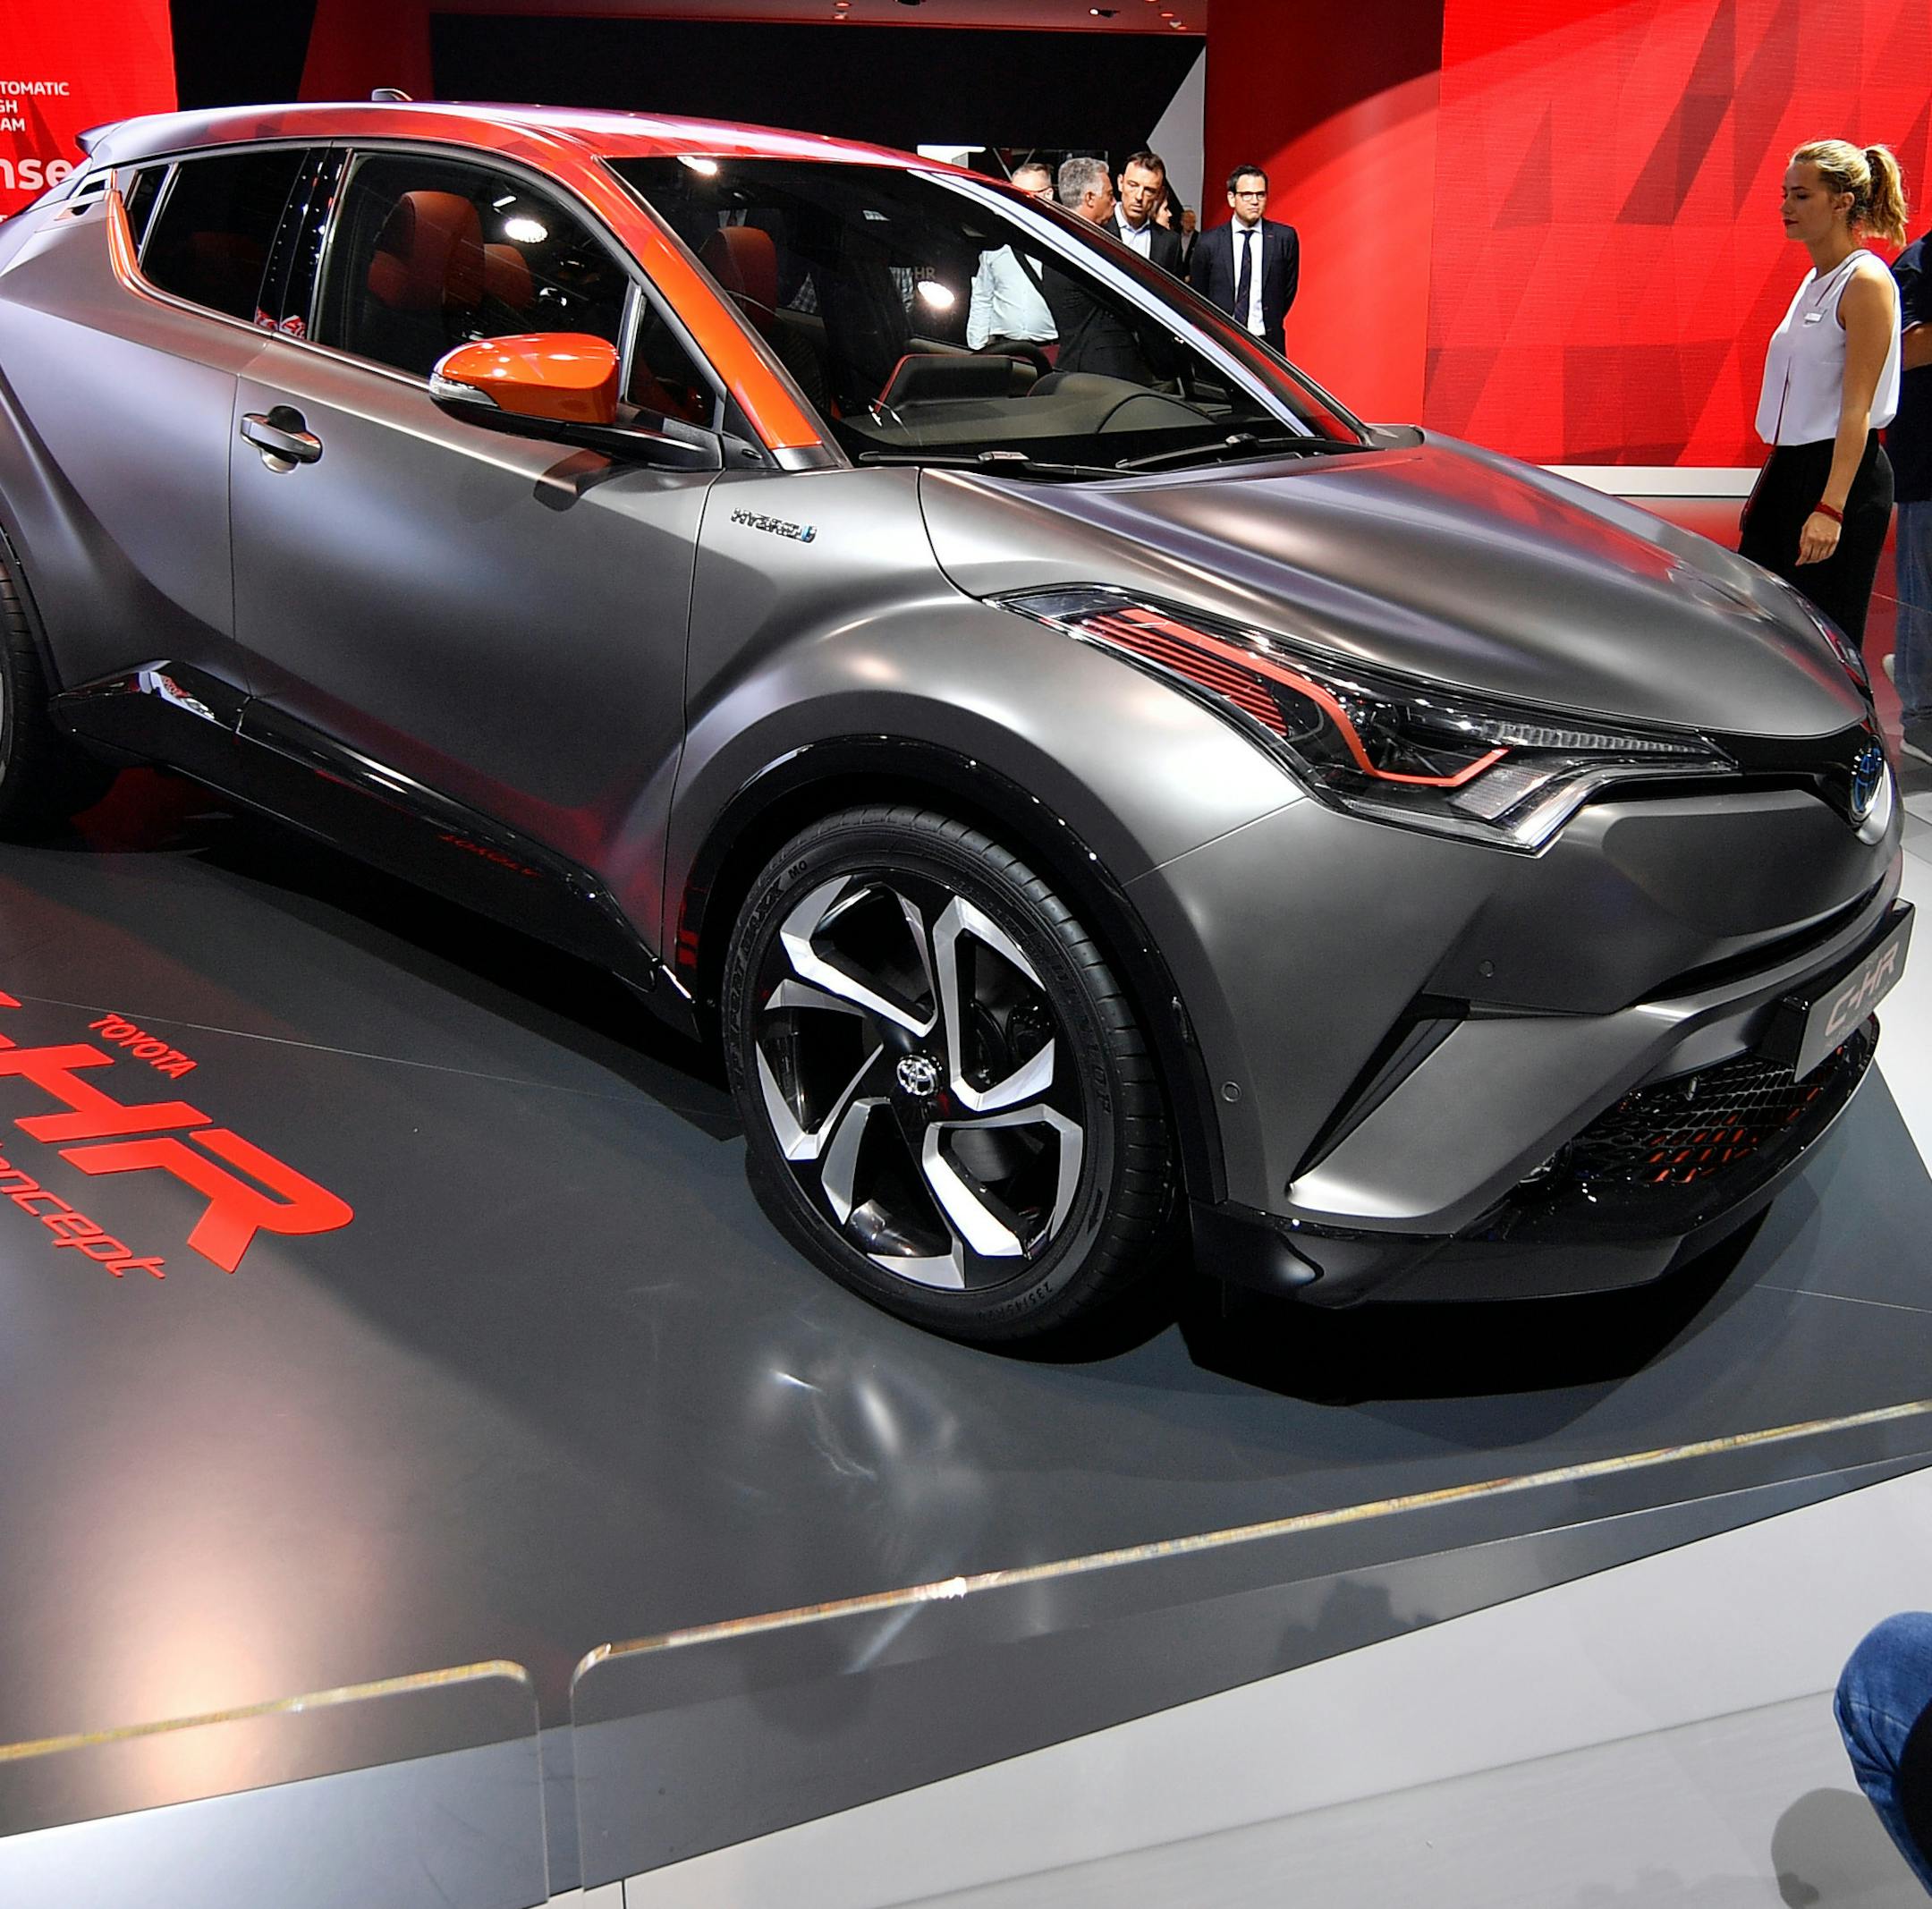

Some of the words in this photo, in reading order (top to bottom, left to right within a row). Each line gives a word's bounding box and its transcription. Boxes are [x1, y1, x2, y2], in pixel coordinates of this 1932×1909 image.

[1825, 942, 1899, 1036] C-HR
[89, 1012, 199, 1079] TOYOTA
[0, 1142, 166, 1279] ncept
